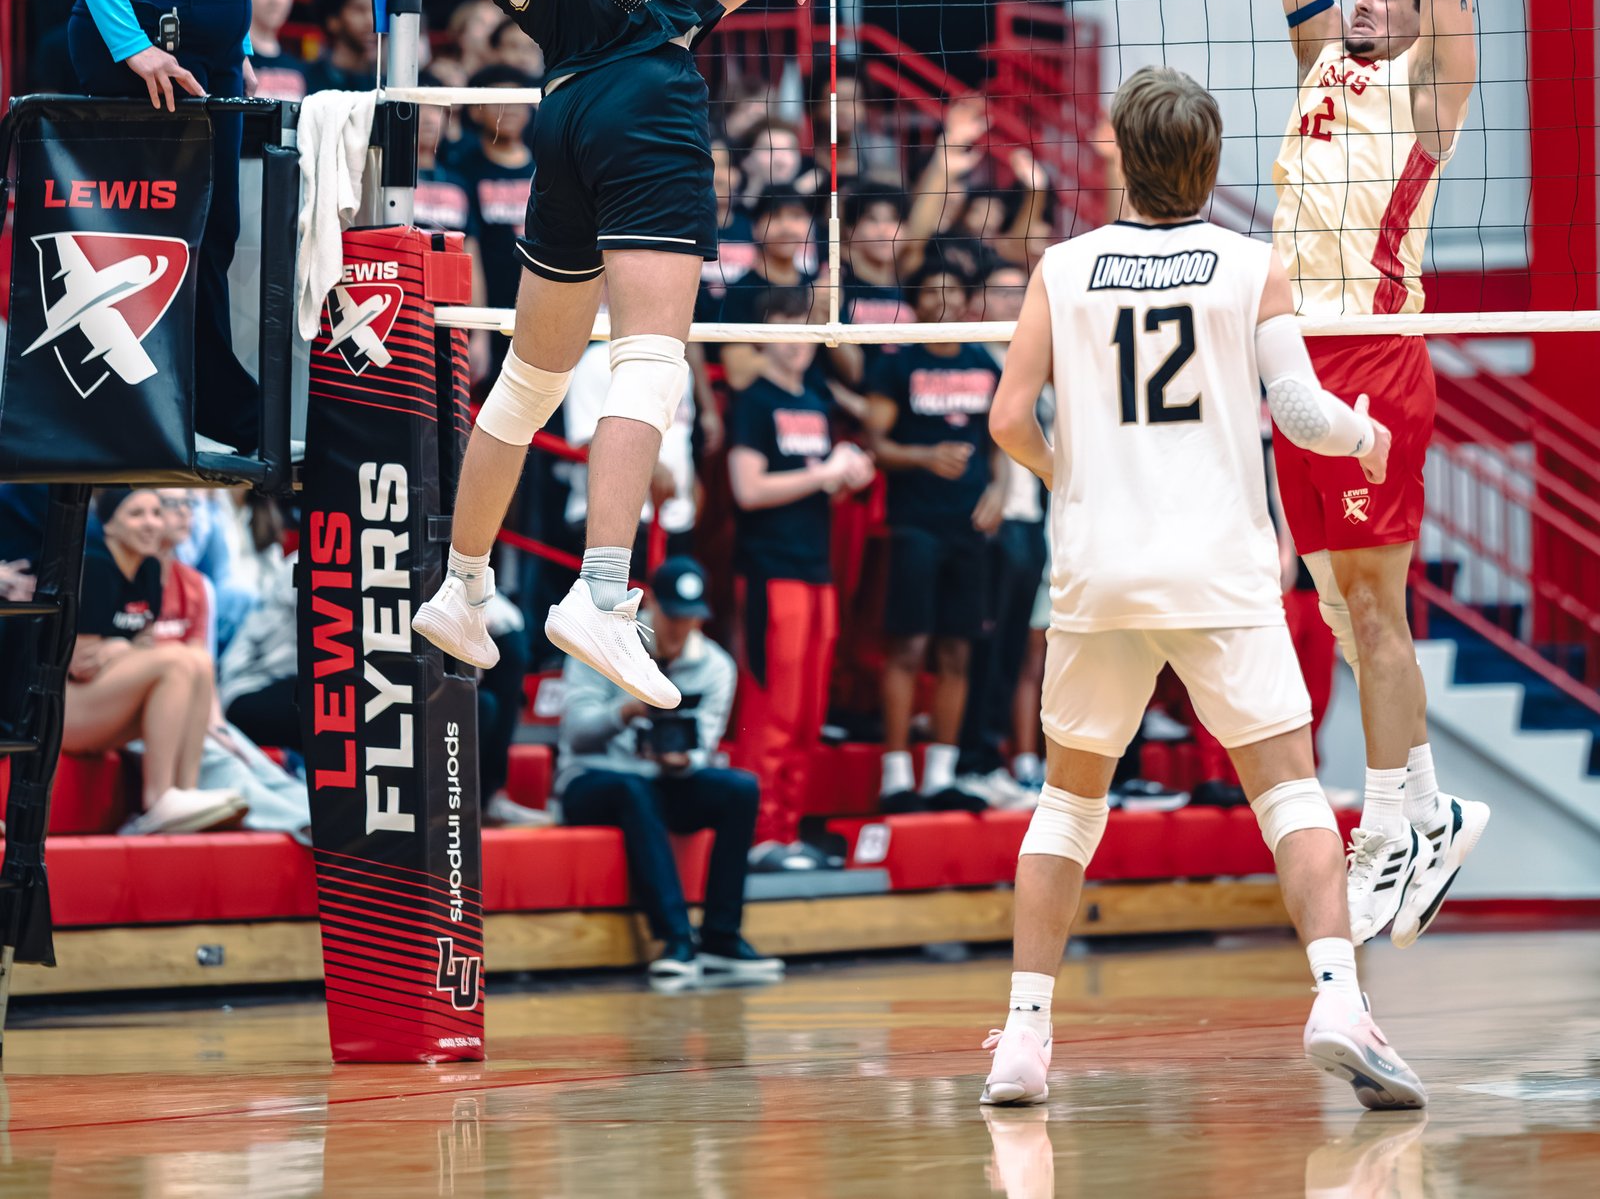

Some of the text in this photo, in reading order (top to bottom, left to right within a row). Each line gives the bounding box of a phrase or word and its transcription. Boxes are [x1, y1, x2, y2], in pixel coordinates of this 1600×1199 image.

[1298, 96, 1336, 142] 12
[44, 179, 178, 209] LEWIS
[342, 261, 399, 283] EWIS
[1087, 250, 1218, 291] LINDENWOOD
[1110, 302, 1203, 426] 12
[1343, 487, 1369, 498] LEWIS
[310, 511, 356, 790] LEWIS
[358, 461, 416, 836] FLYERS
[444, 721, 463, 923] sports imports
[436, 937, 481, 1011] LU
